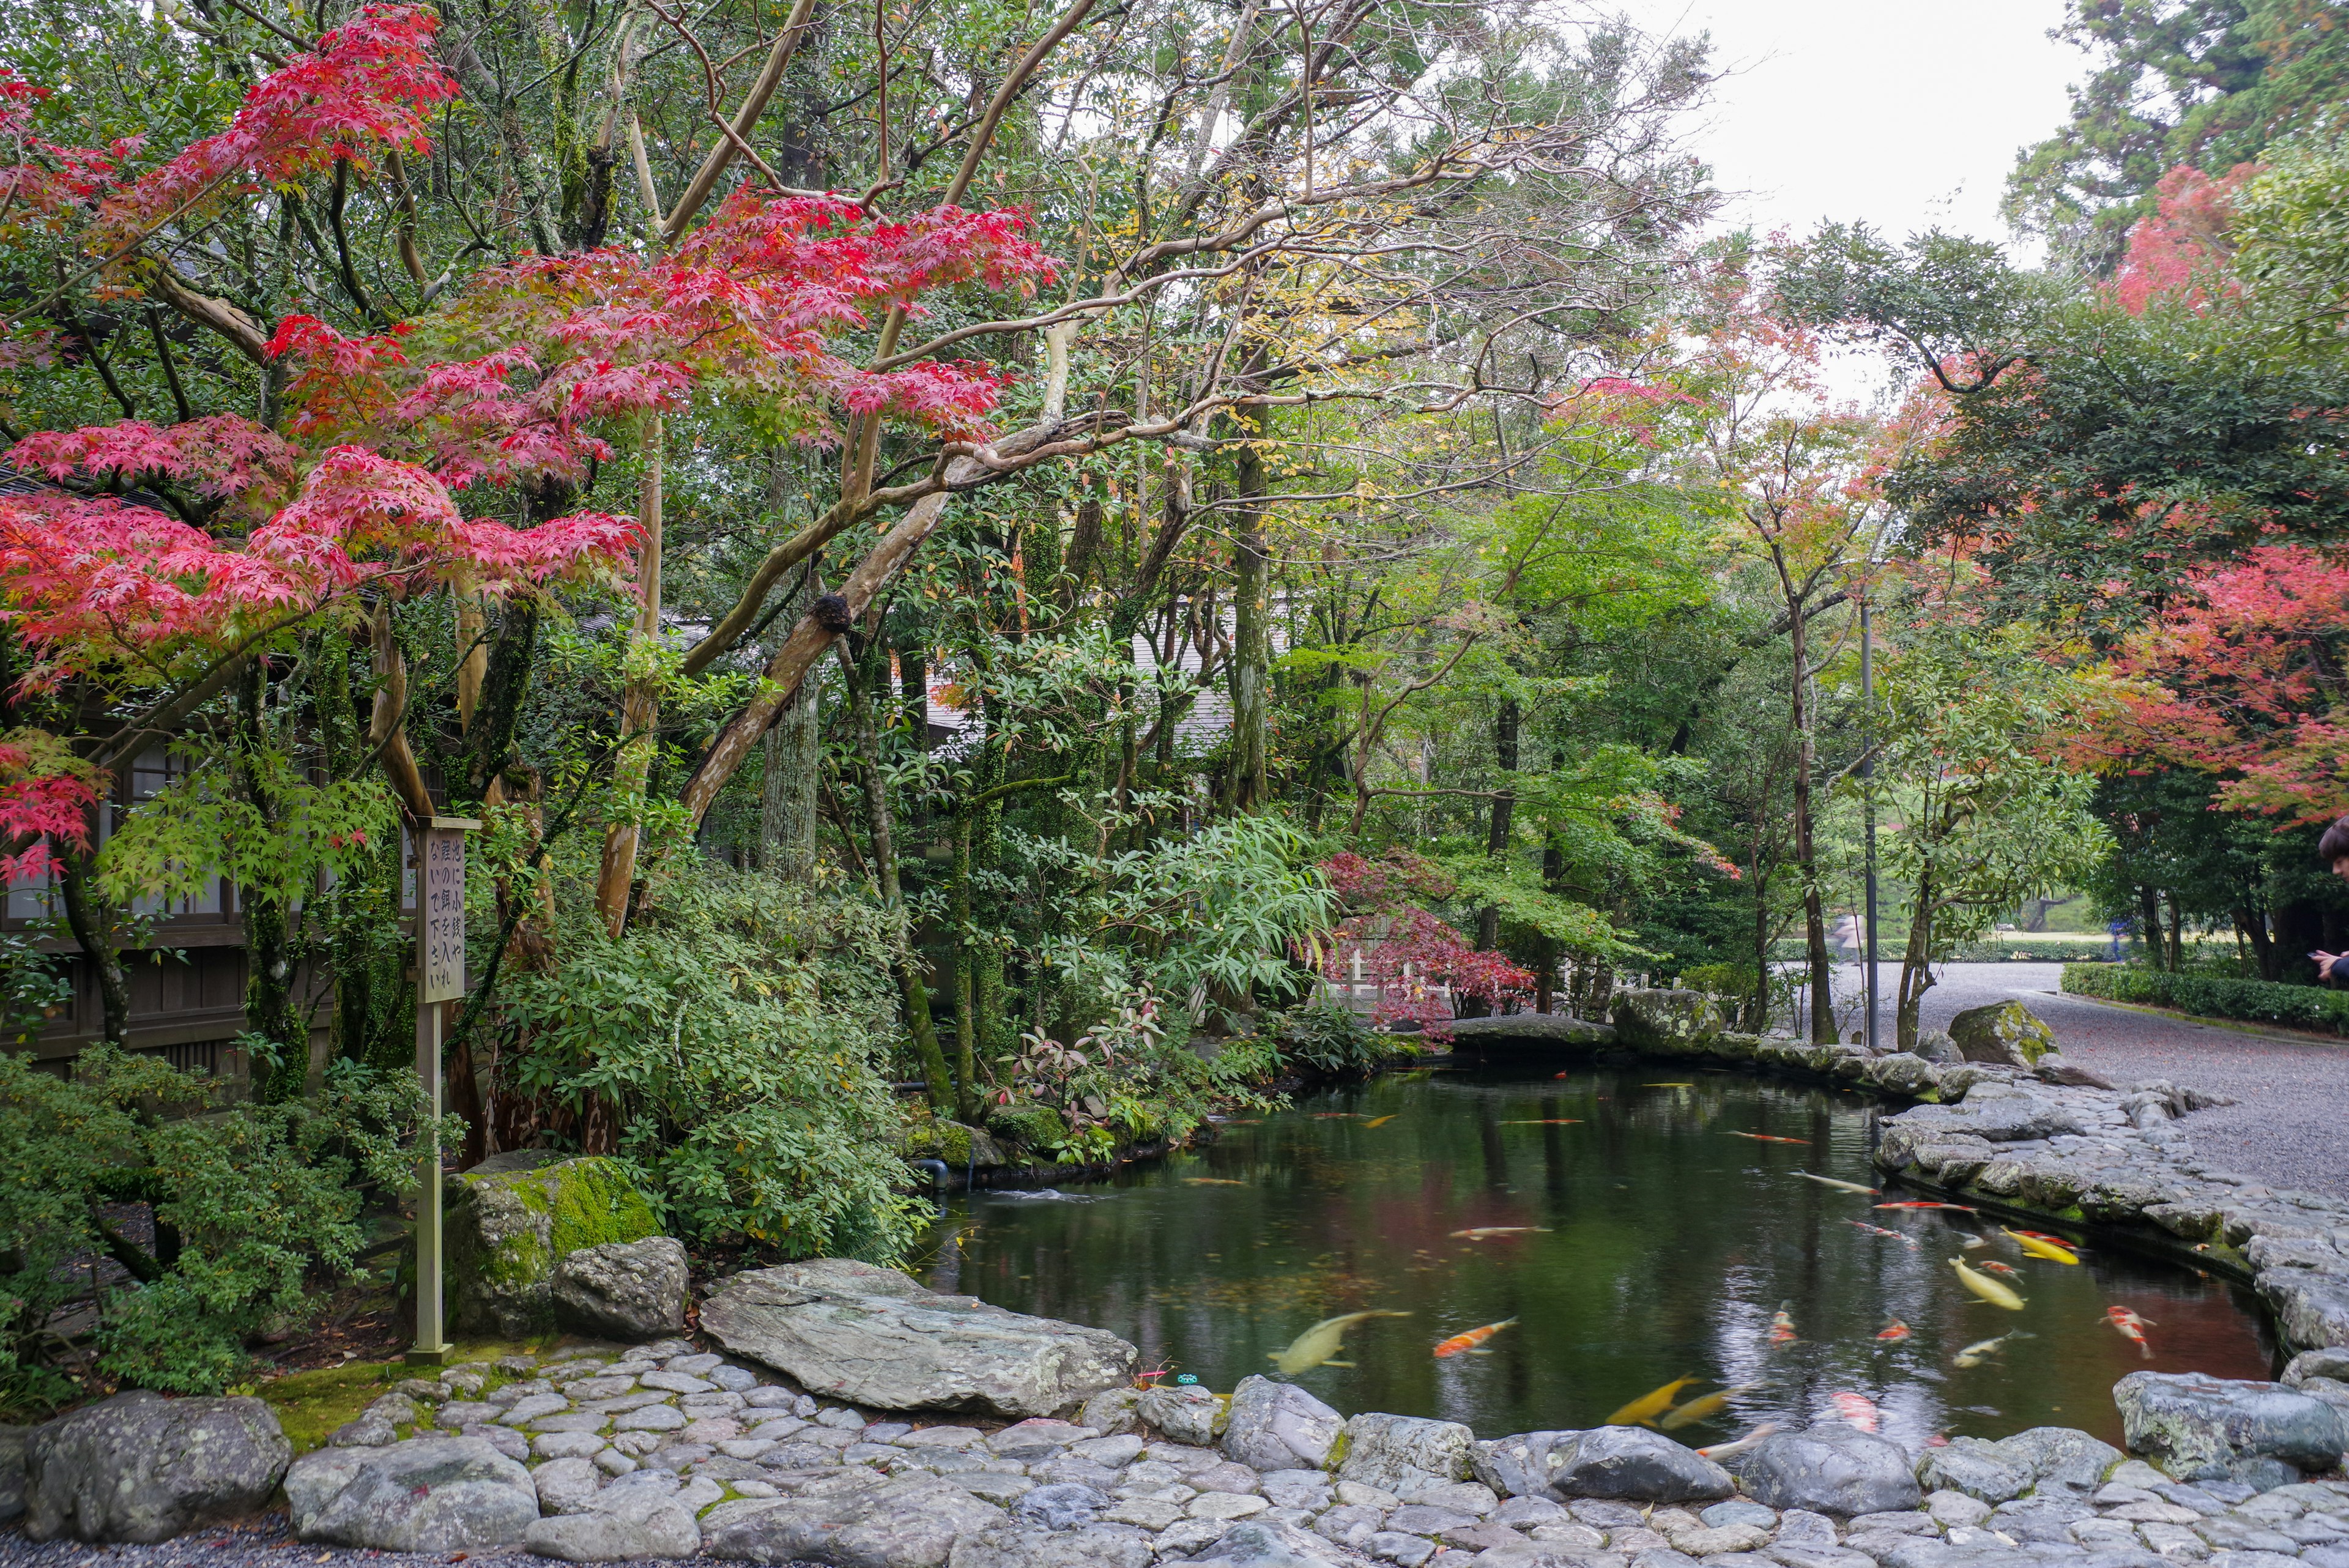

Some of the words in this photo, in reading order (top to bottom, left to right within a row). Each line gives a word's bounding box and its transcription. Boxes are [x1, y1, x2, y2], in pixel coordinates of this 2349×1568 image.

[430, 840, 439, 990] ないで下さい
[441, 839, 451, 989] 鯉の餌を入れ
[452, 839, 461, 962] 池に小銭や
